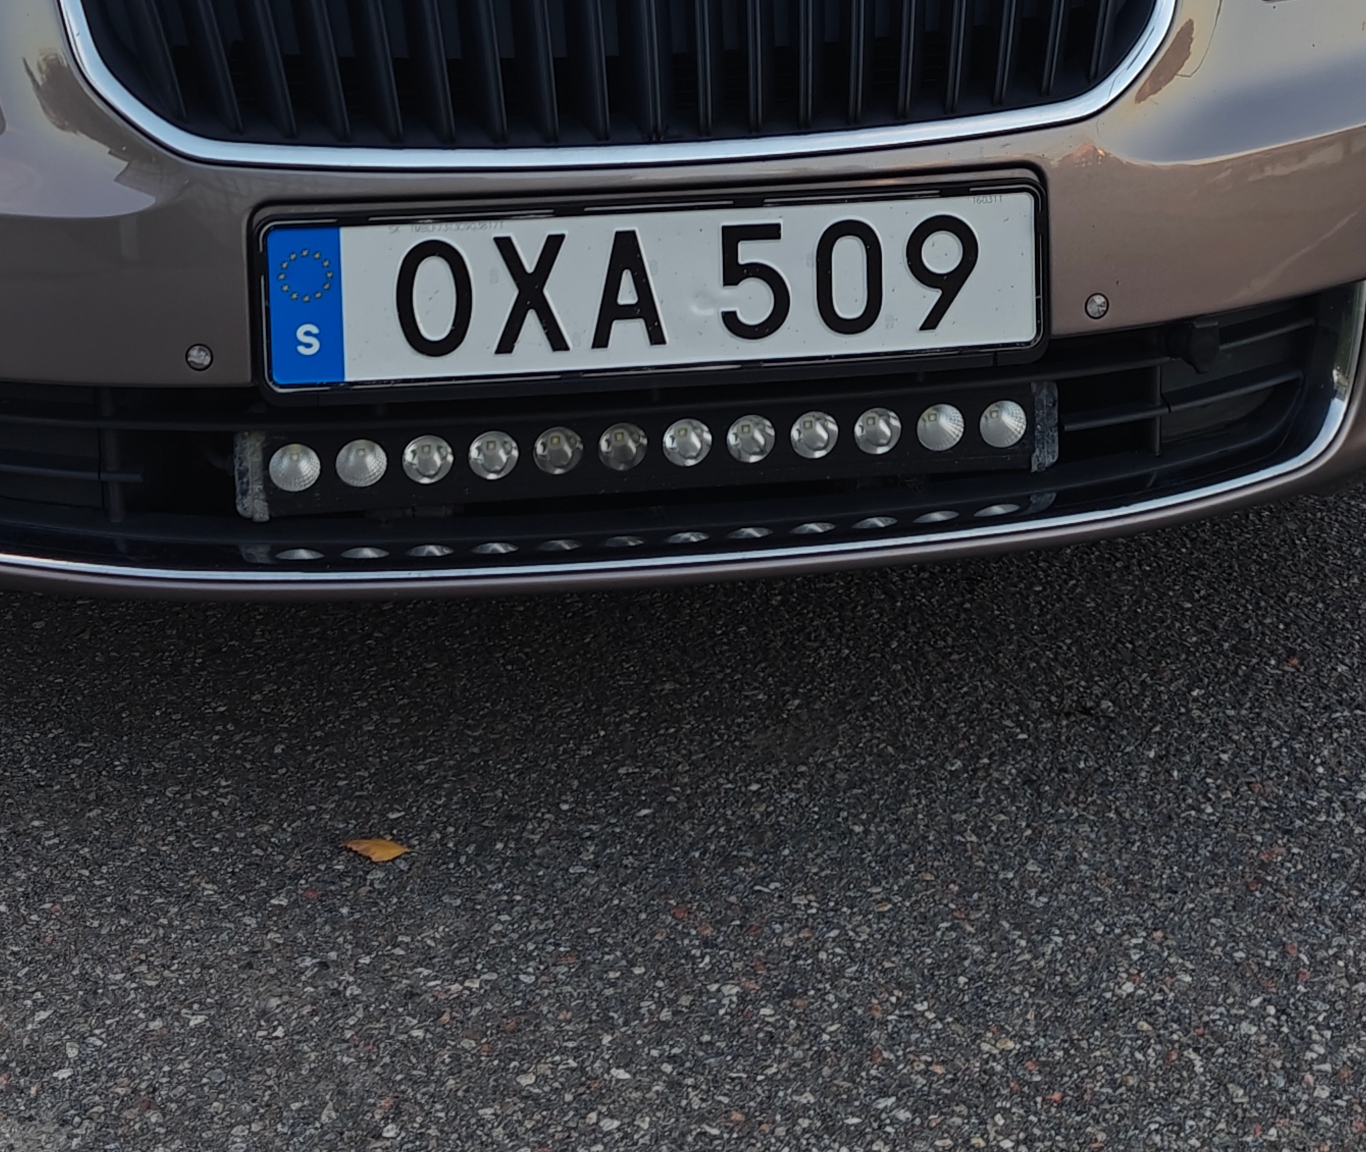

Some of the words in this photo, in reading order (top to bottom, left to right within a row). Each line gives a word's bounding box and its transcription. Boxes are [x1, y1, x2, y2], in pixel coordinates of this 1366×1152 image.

[296, 323, 321, 356] S
[396, 229, 667, 357] OXA
[721, 214, 979, 340] 509
